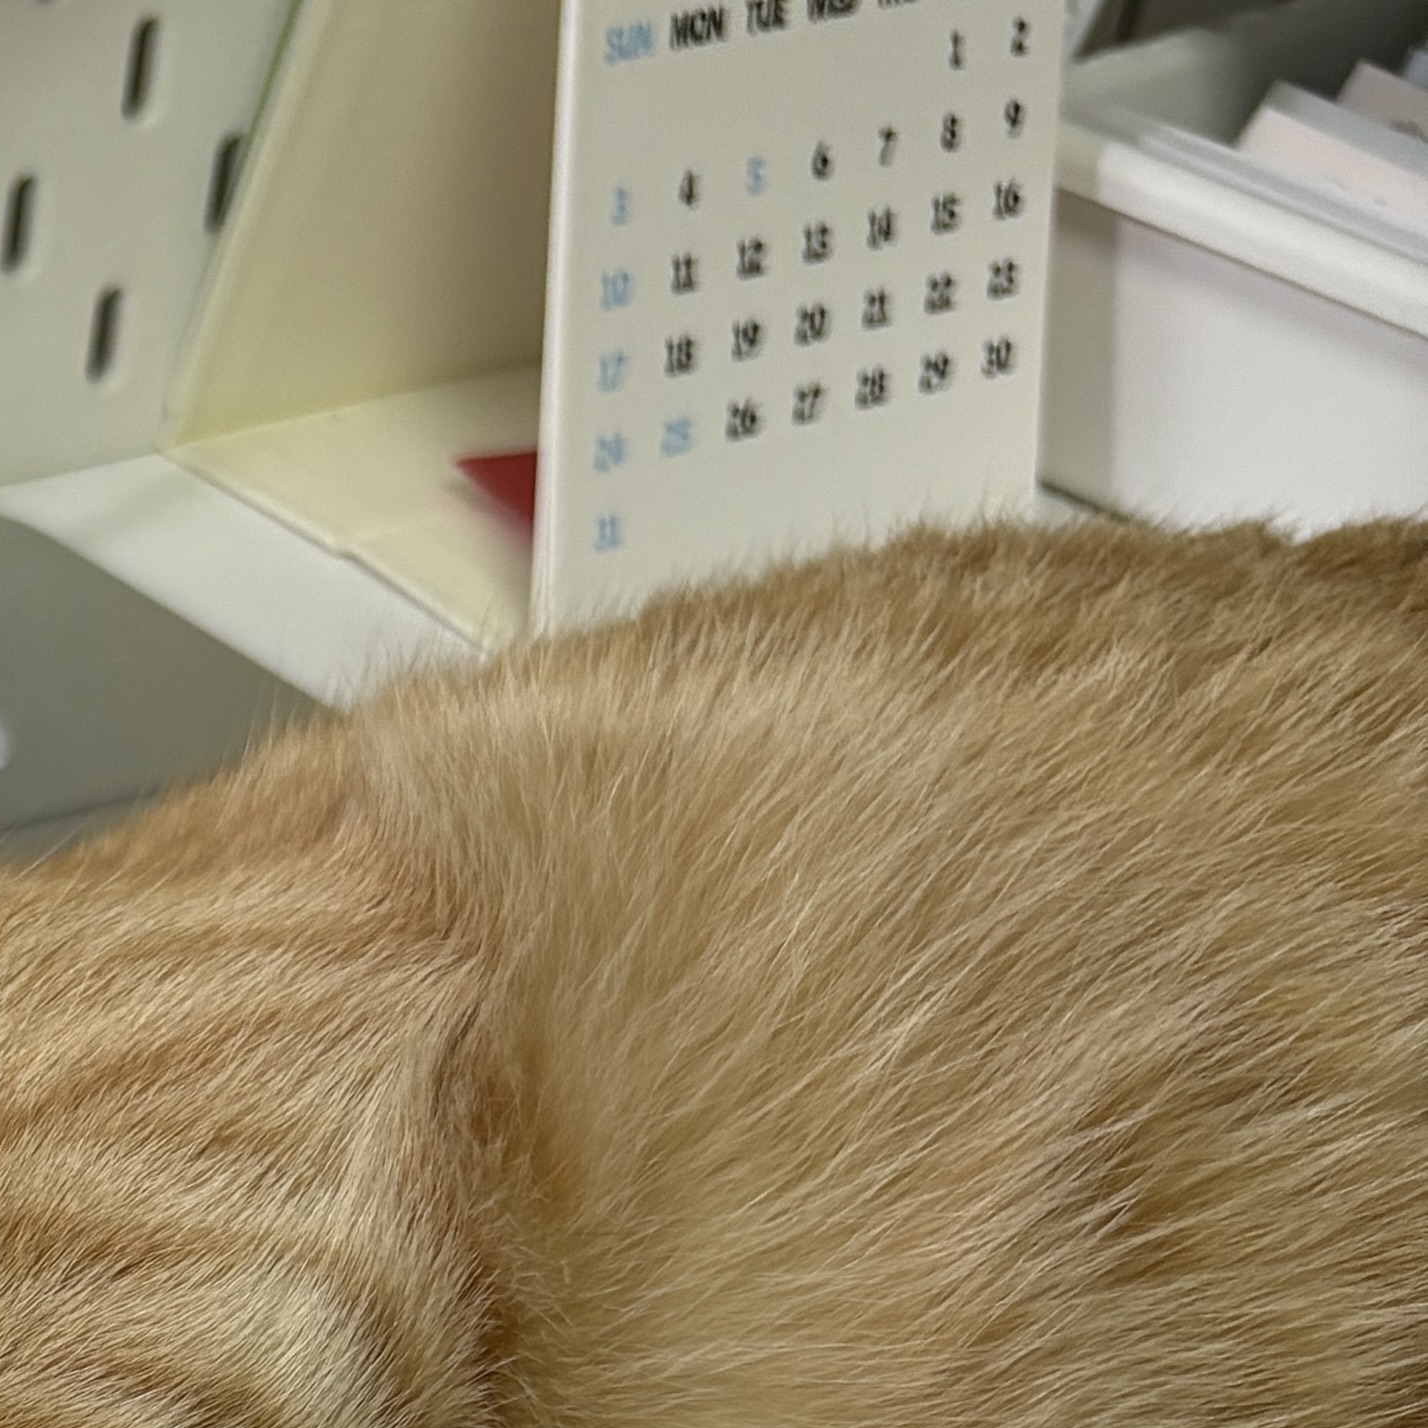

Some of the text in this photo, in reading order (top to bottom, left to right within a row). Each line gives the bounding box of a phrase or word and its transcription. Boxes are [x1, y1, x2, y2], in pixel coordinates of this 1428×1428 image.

[669, 4, 729, 52] MON
[948, 16, 1032, 72] 1 2
[677, 169, 701, 210] 4
[810, 140, 835, 182] 6
[878, 124, 900, 168] 7
[939, 111, 964, 154] 8
[1003, 98, 1027, 139] 9
[671, 251, 700, 296] 11
[735, 236, 769, 281] 12
[801, 219, 835, 266] 13
[866, 205, 899, 252] 14
[929, 191, 963, 236] 15
[991, 177, 1026, 222] 16
[663, 333, 700, 379] 18
[730, 317, 766, 363] 19
[793, 301, 833, 348] 20
[860, 285, 894, 332] 21
[923, 270, 959, 316] 22
[986, 256, 1021, 301] 23
[724, 396, 764, 443] 26
[791, 380, 829, 426] 27
[854, 364, 893, 411] 28
[917, 349, 956, 395] 29
[980, 335, 1018, 380] 30
